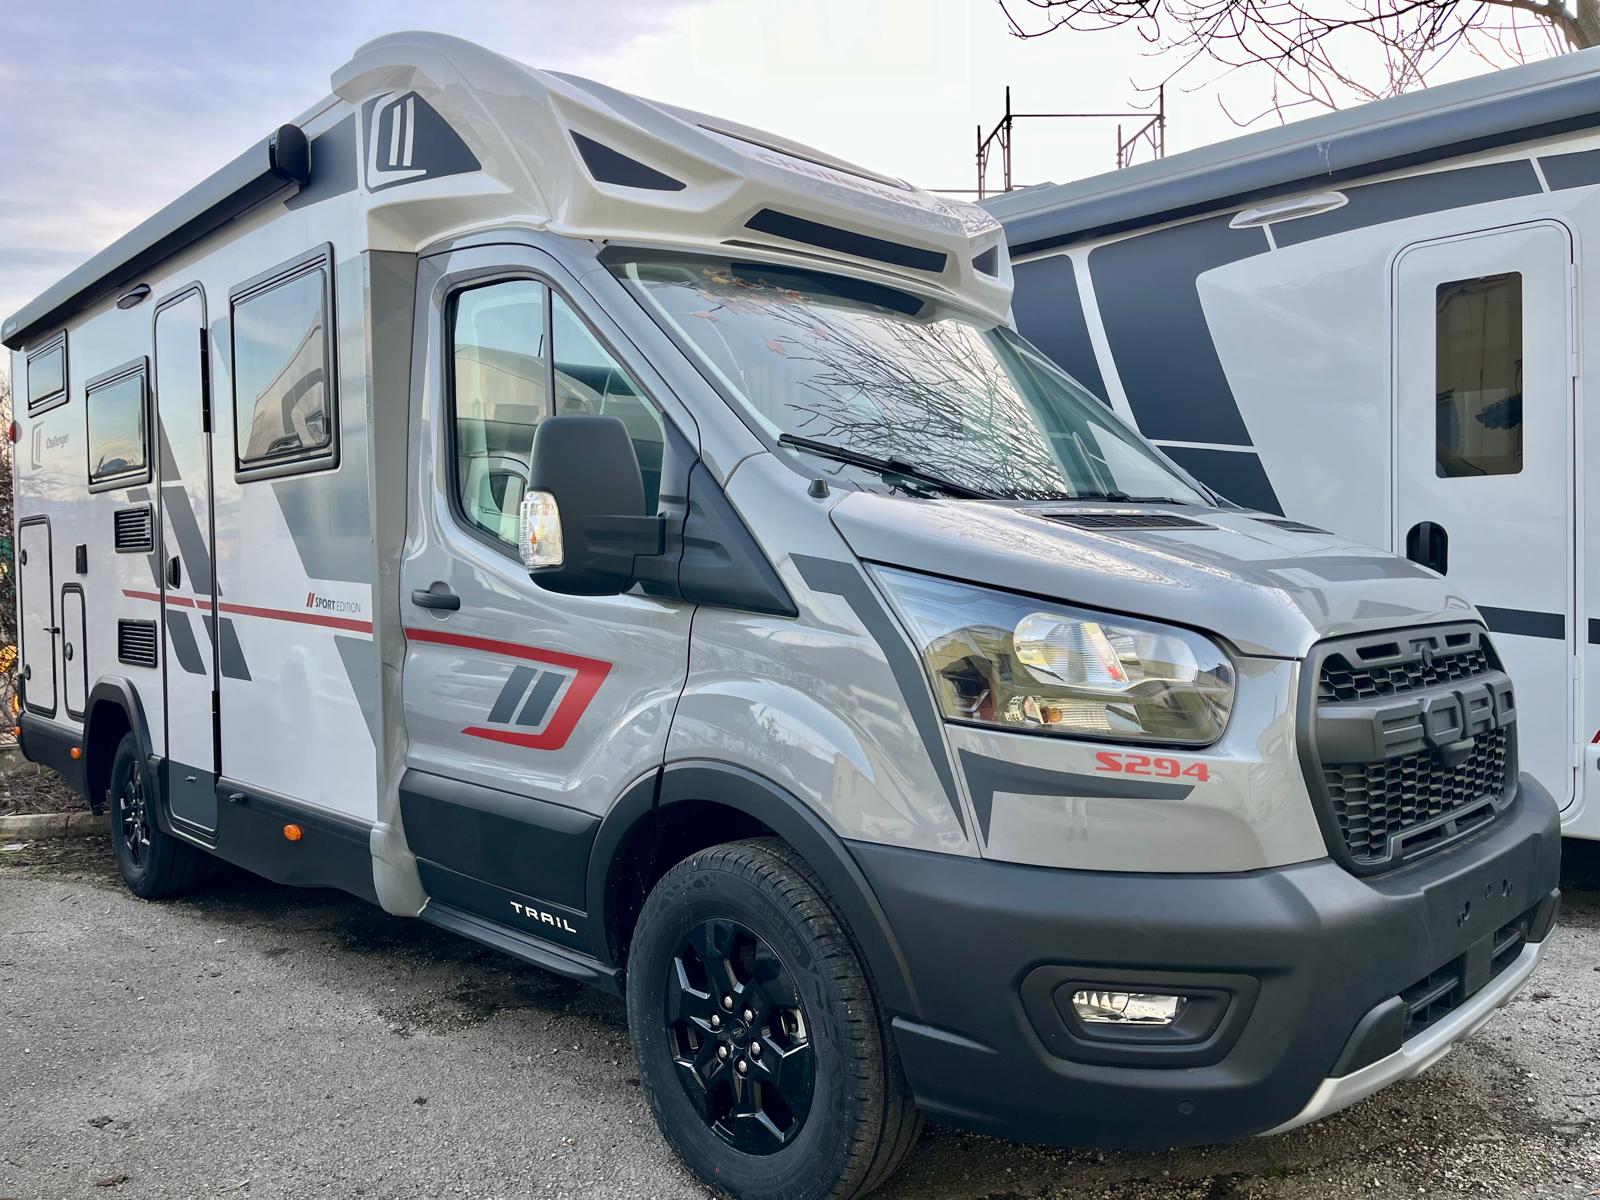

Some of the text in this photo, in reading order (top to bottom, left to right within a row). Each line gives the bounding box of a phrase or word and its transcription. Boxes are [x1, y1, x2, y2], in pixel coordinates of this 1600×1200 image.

[315, 596, 361, 613] SPORT EDITION
[1373, 682, 1517, 762] FORD
[1095, 751, 1211, 783] S294
[510, 900, 577, 934] TRAIL
